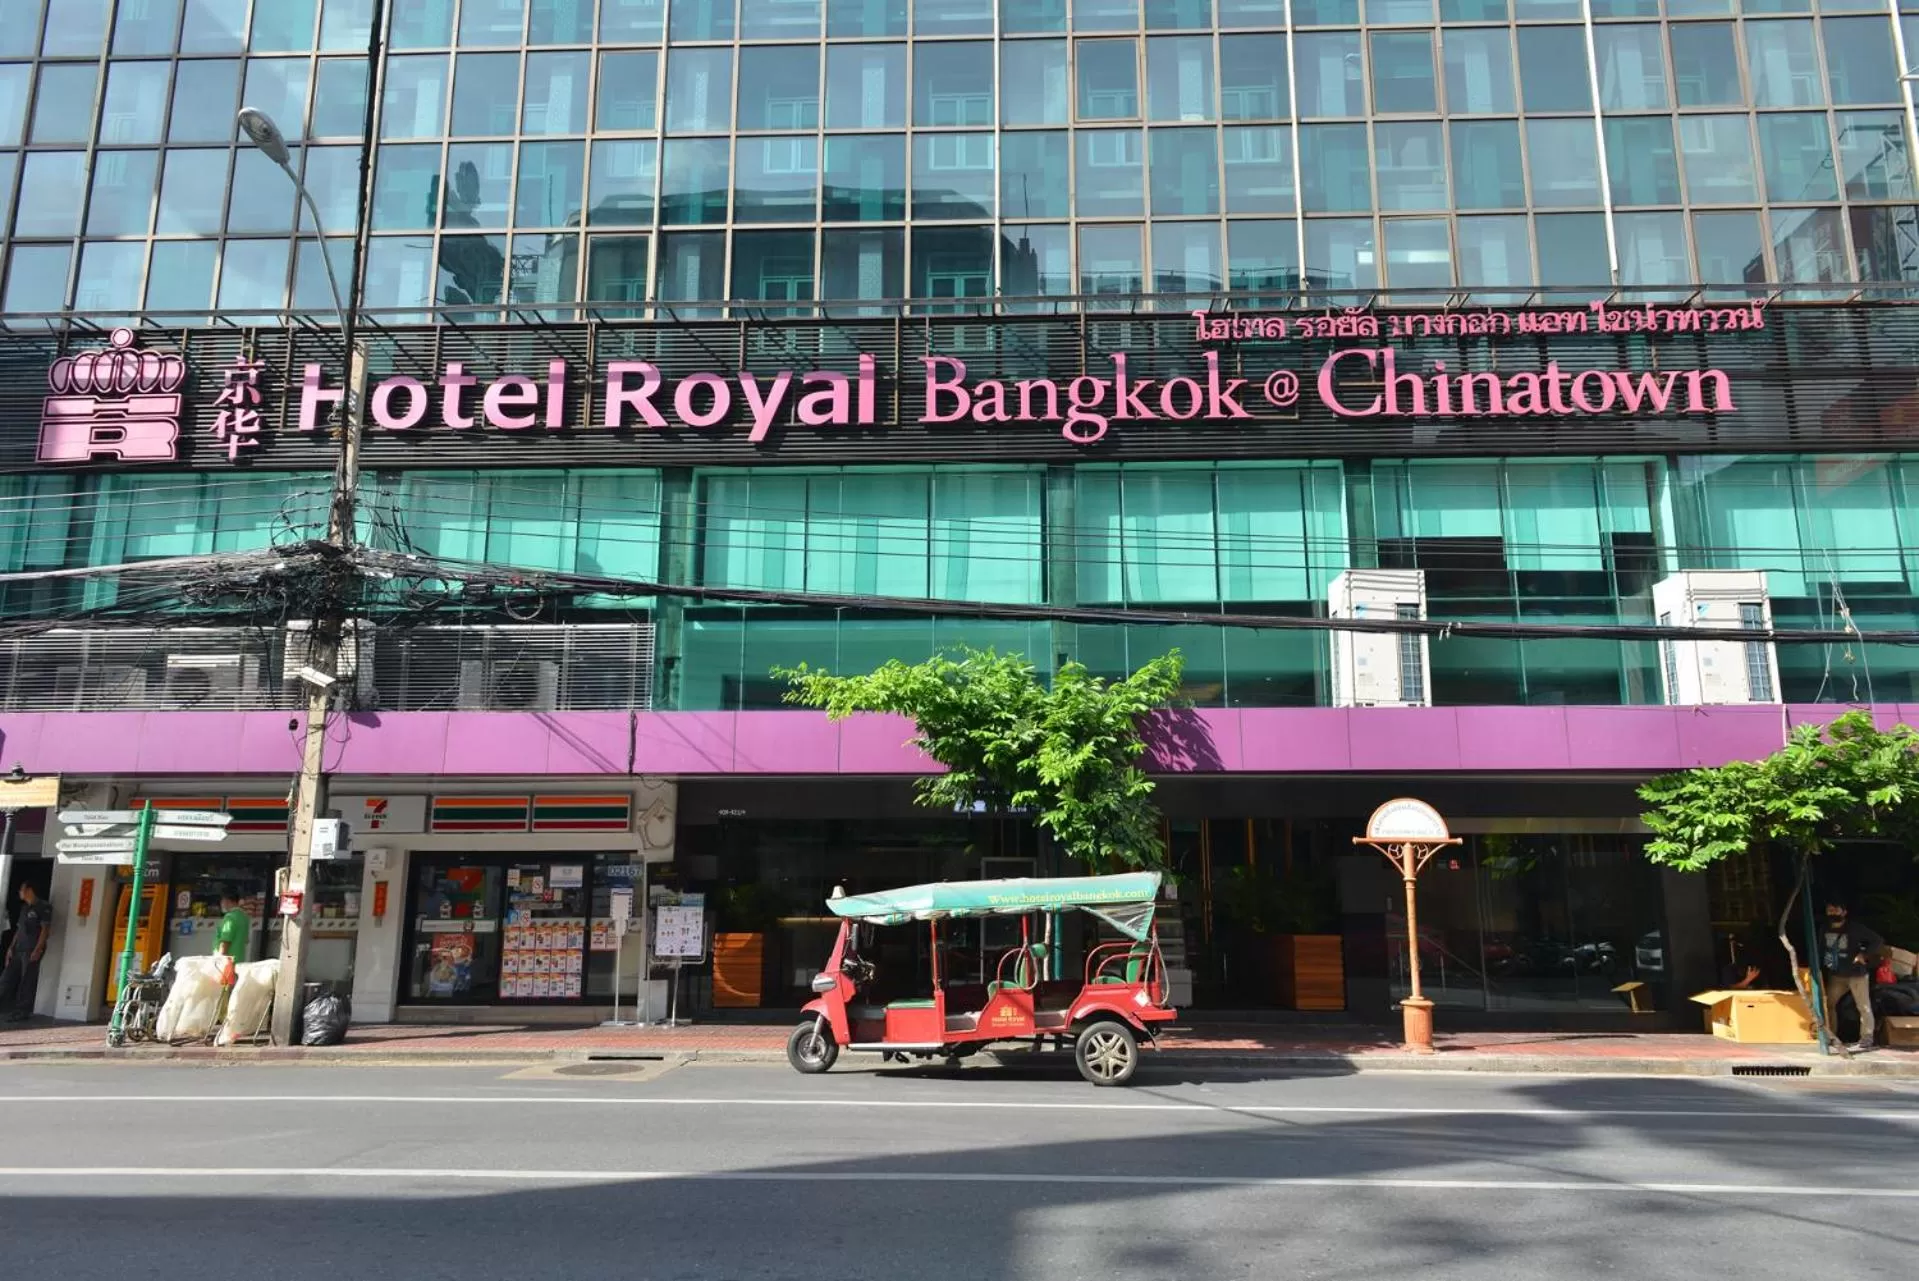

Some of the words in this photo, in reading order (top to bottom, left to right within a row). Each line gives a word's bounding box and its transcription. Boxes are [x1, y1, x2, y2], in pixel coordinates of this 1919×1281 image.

[1296, 307, 1379, 337] รอยัล
[1388, 312, 1511, 336] บางกอก
[208, 355, 266, 462] 京华
[299, 358, 565, 431] Hotel
[603, 353, 875, 442] Royal
[918, 351, 1255, 444] Bangkok
[1264, 369, 1300, 406] @
[1317, 346, 1738, 417] Chinatown
